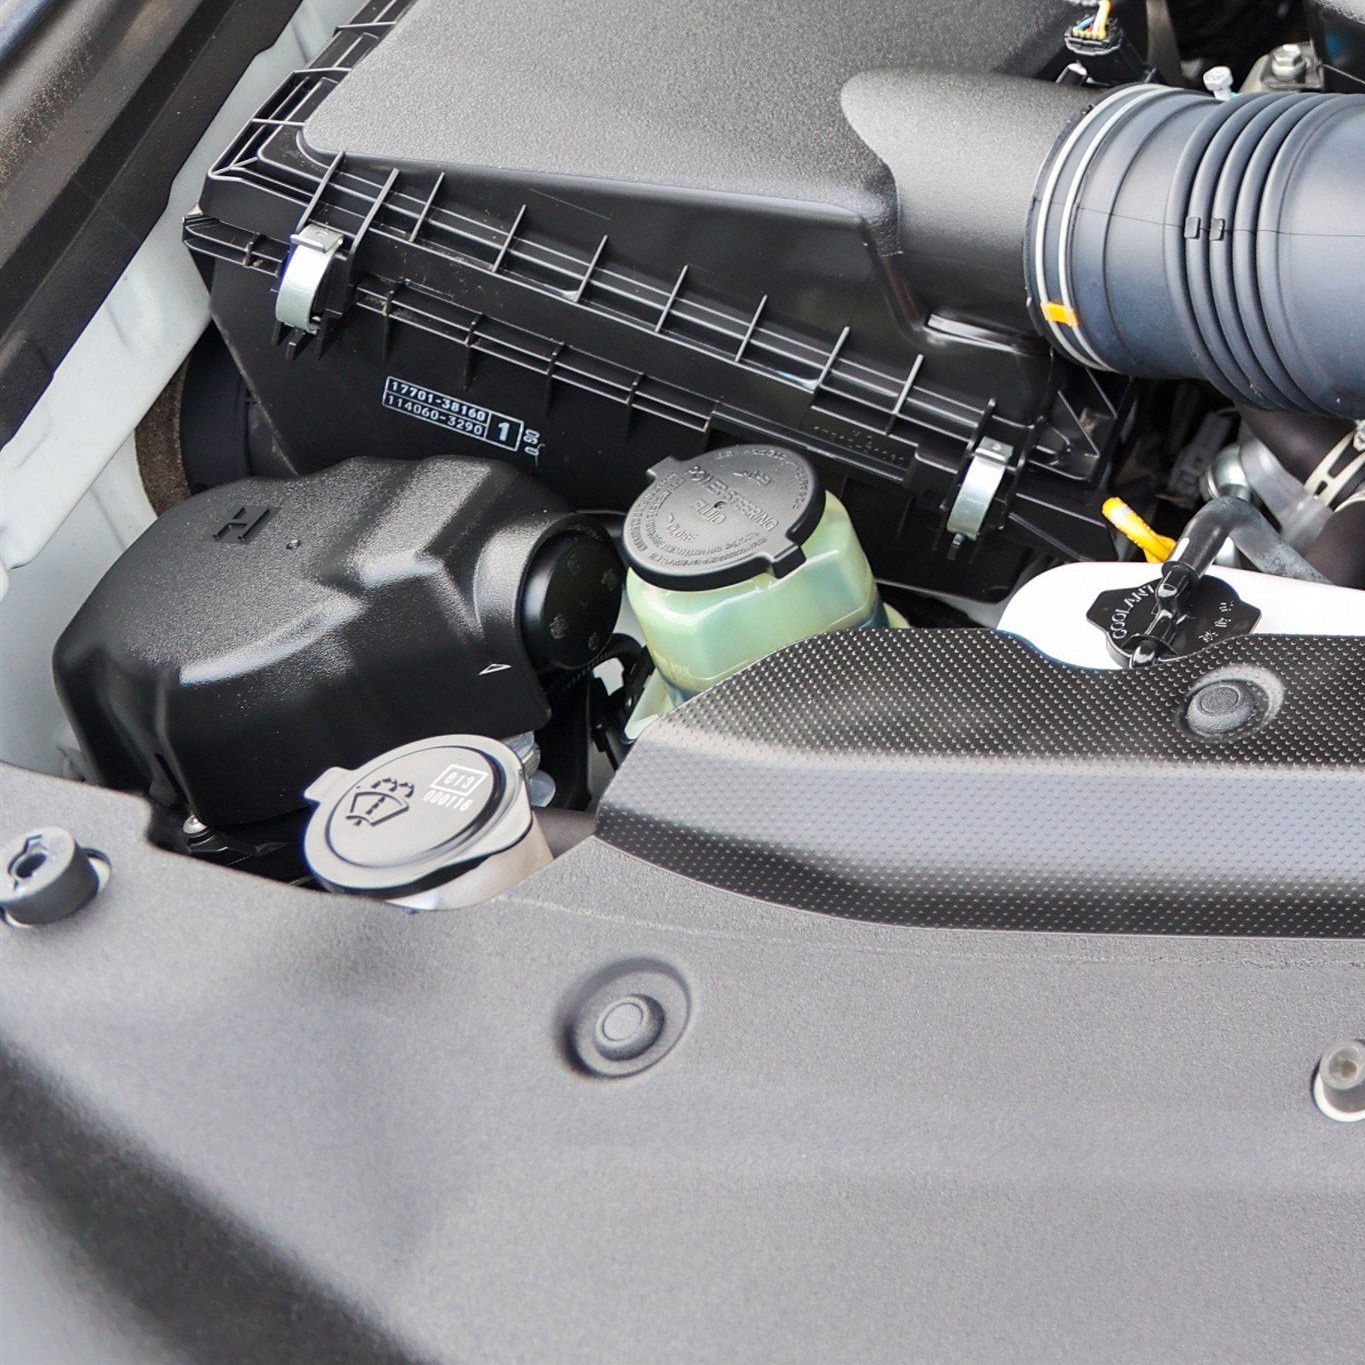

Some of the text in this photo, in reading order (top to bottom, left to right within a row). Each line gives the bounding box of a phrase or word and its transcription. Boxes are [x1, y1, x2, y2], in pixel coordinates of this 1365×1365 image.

[386, 394, 483, 436] 114060-3290
[391, 381, 486, 422] 17701-38160
[498, 422, 511, 442] 1
[691, 499, 727, 526] FLUID
[723, 488, 780, 533] STEERING
[1109, 584, 1155, 639] COOLANT
[443, 771, 476, 789] e13
[422, 789, 474, 812] 000116
